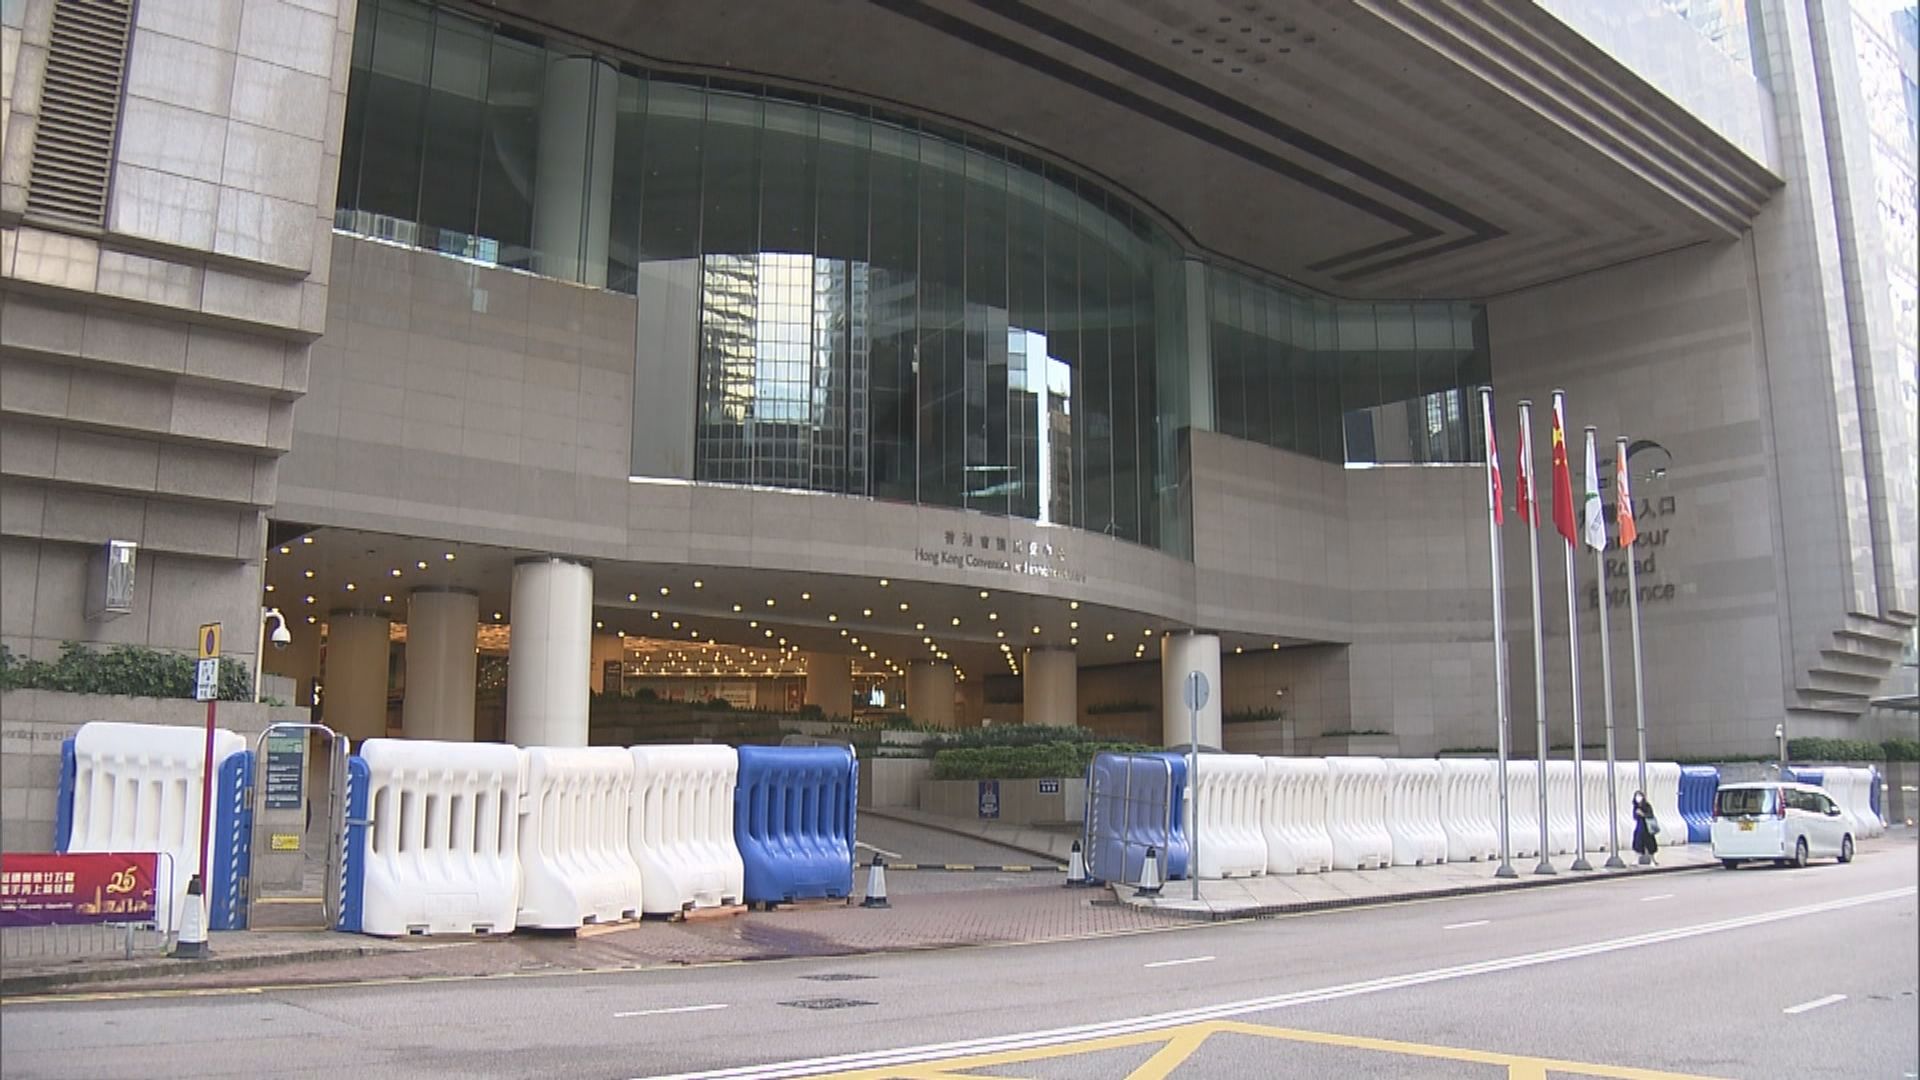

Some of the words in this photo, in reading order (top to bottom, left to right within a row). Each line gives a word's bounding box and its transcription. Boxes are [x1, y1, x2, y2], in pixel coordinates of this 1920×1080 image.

[915, 548, 939, 566] Hong
[941, 551, 964, 569] Kong
[106, 865, 138, 893] 25
